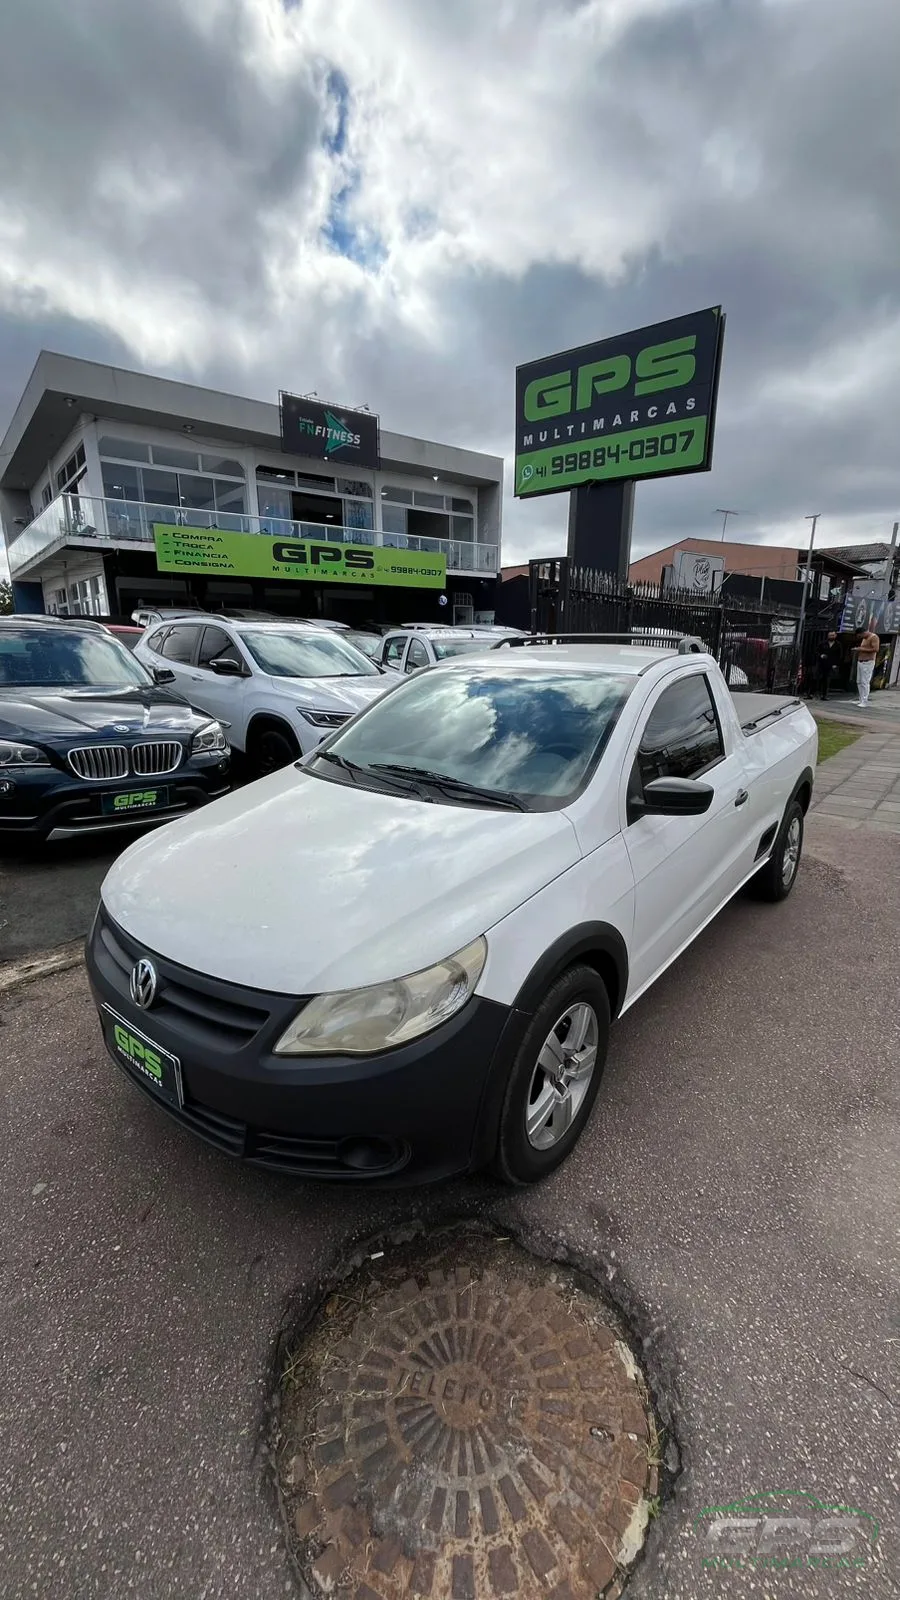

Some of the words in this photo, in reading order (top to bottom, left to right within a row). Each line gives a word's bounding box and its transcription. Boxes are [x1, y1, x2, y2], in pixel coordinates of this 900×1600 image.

[524, 335, 697, 422] GPS
[523, 398, 696, 446] MULTIMARCAS
[536, 465, 547, 478] 41
[551, 429, 695, 475] 99884-0307
[172, 532, 223, 543] COMPRA
[173, 541, 214, 550] TROCA
[173, 550, 229, 559] FINANCIA
[272, 542, 375, 569] GPS
[174, 559, 235, 569] CONSIGNA
[390, 565, 442, 577] 99884-0307
[272, 565, 375, 579] MULTIMARCAS
[113, 791, 157, 807] GPS
[114, 802, 156, 811] MULTIMARCAS
[114, 1024, 162, 1079] GPS
[117, 1045, 163, 1088] MULTIMARCAS
